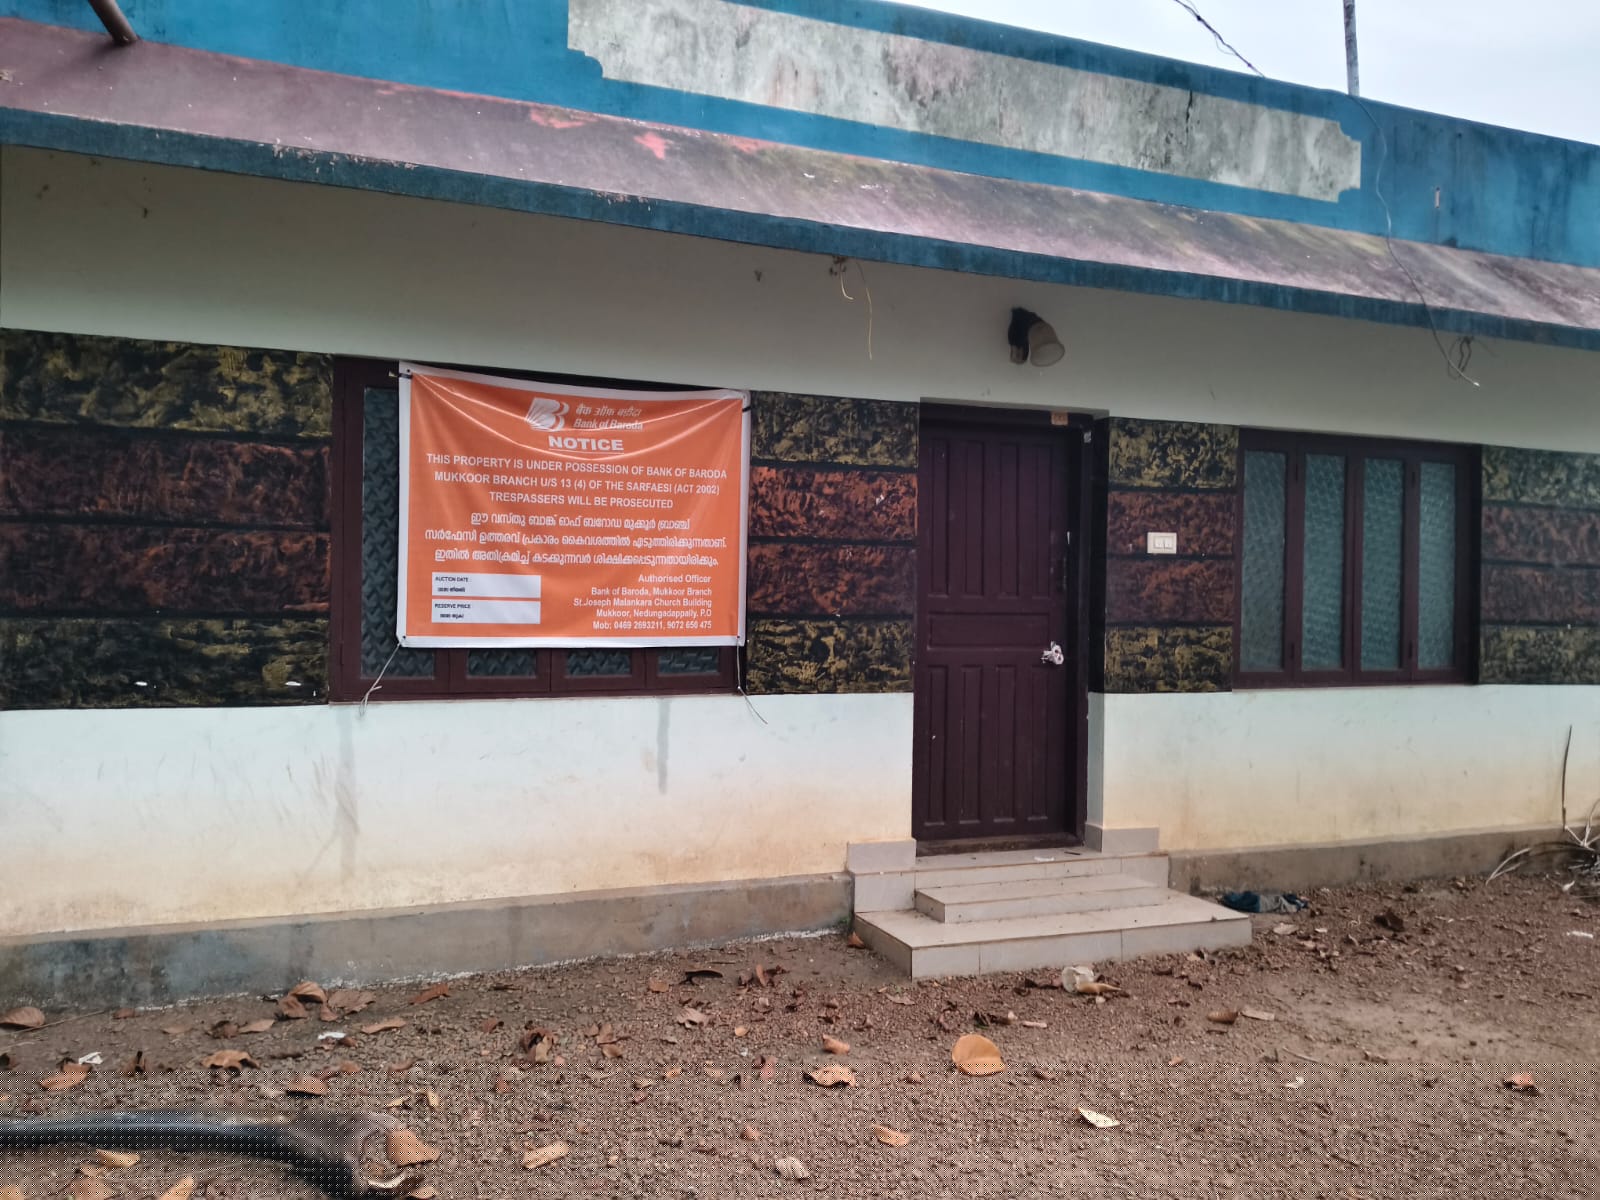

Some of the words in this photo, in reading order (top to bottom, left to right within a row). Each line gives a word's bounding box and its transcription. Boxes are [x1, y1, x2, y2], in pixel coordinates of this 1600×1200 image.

[574, 419, 597, 428] Bank
[599, 419, 609, 428] of
[610, 419, 643, 430] Baroda
[548, 436, 624, 450] NOTICE
[427, 454, 450, 464] THIS
[454, 455, 511, 467] PROPERTY
[514, 458, 523, 468] IS
[527, 459, 562, 471] UNDER
[565, 461, 628, 474] POSSESSION
[632, 466, 644, 475] OF
[647, 466, 672, 476] BANK
[675, 469, 686, 477] OF
[689, 469, 727, 478] BARODA
[435, 472, 489, 483] MUKKOOR
[493, 475, 537, 486] BRANCH
[541, 477, 557, 487] U/S
[560, 477, 571, 487] 13
[574, 478, 586, 490] (4)
[589, 480, 602, 489] OF
[605, 481, 623, 490] THE
[627, 482, 672, 493] SARFAESI
[674, 484, 693, 494] (ACT
[696, 485, 719, 495] 2002)
[489, 492, 564, 504] TRESPASSERS
[568, 495, 591, 506] WILL
[594, 497, 607, 506] BE
[610, 497, 673, 509] PROSECUTED
[471, 512, 488, 525] ഈ
[491, 513, 525, 526] വസ്തു
[529, 514, 556, 526] ബാങ്ക്
[559, 516, 581, 527] ഓഫ്
[479, 531, 520, 544] ഉത്തരവ്
[522, 534, 559, 545] പ്രകാരം
[435, 548, 469, 561] ഇതിൽ
[638, 574, 682, 582] Authorised
[685, 575, 711, 583] Officer
[592, 587, 610, 595] Bank
[614, 598, 652, 606] Malankara
[655, 598, 680, 606] Church
[683, 598, 712, 608] Building
[667, 621, 683, 629] 9072
